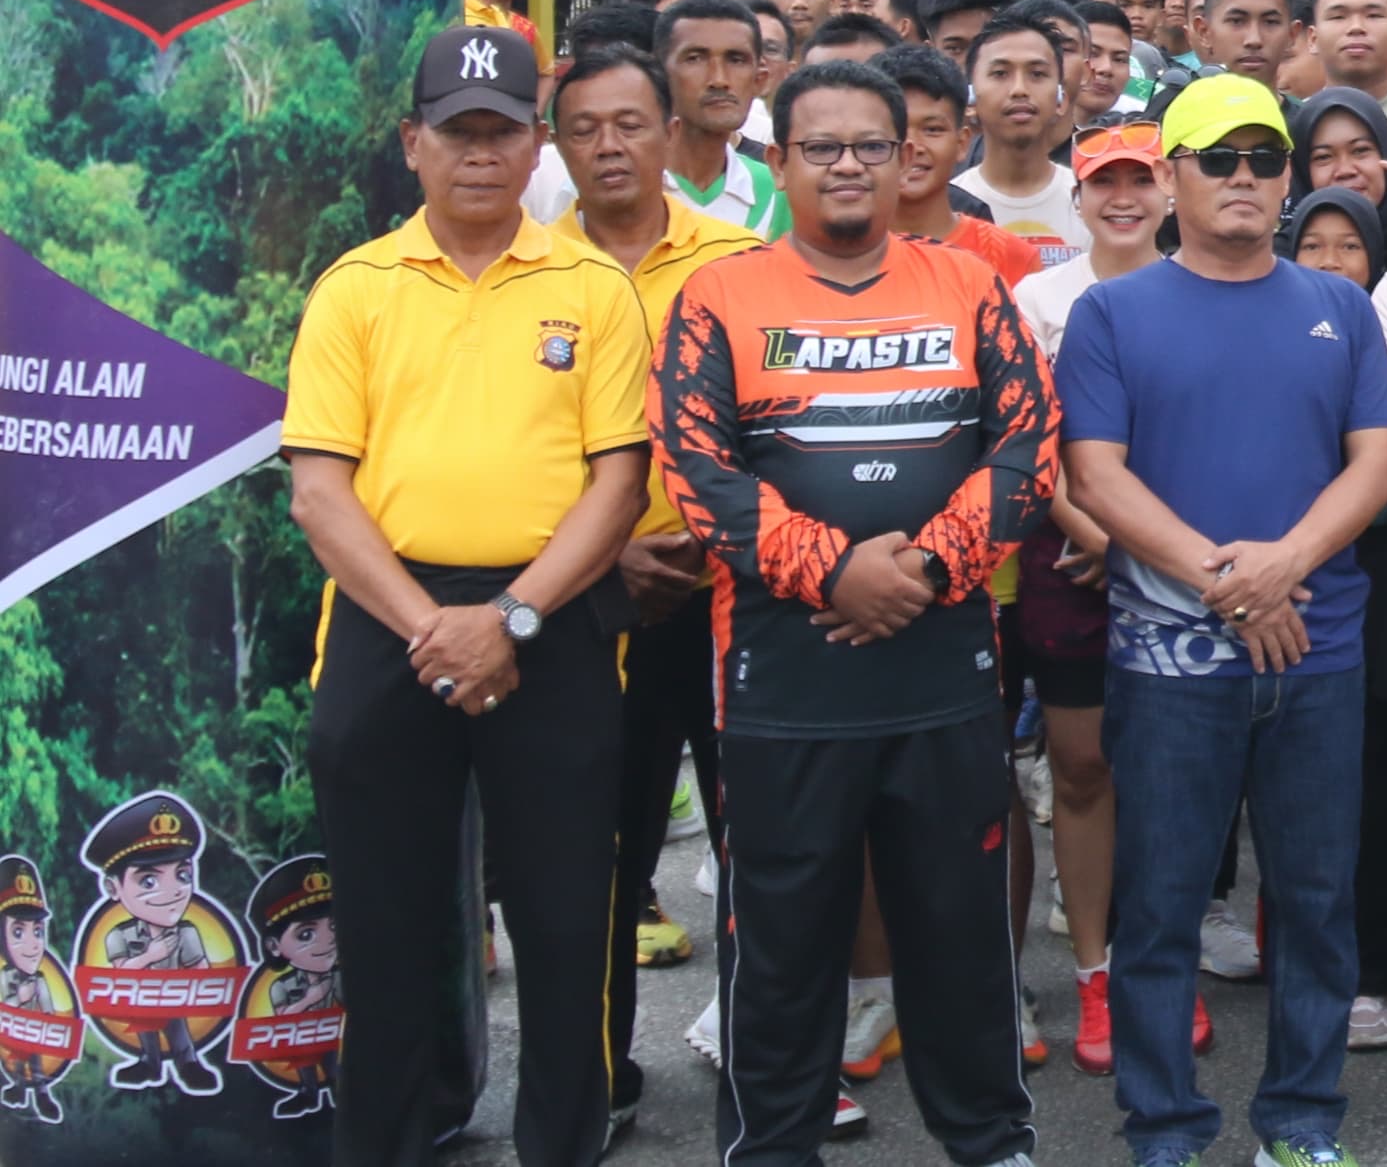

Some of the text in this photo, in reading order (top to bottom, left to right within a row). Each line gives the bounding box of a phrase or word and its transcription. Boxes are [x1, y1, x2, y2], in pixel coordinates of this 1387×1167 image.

[764, 329, 954, 369] LAPASTE
[53, 360, 147, 399] ALAM
[87, 978, 235, 1007] PRESISI
